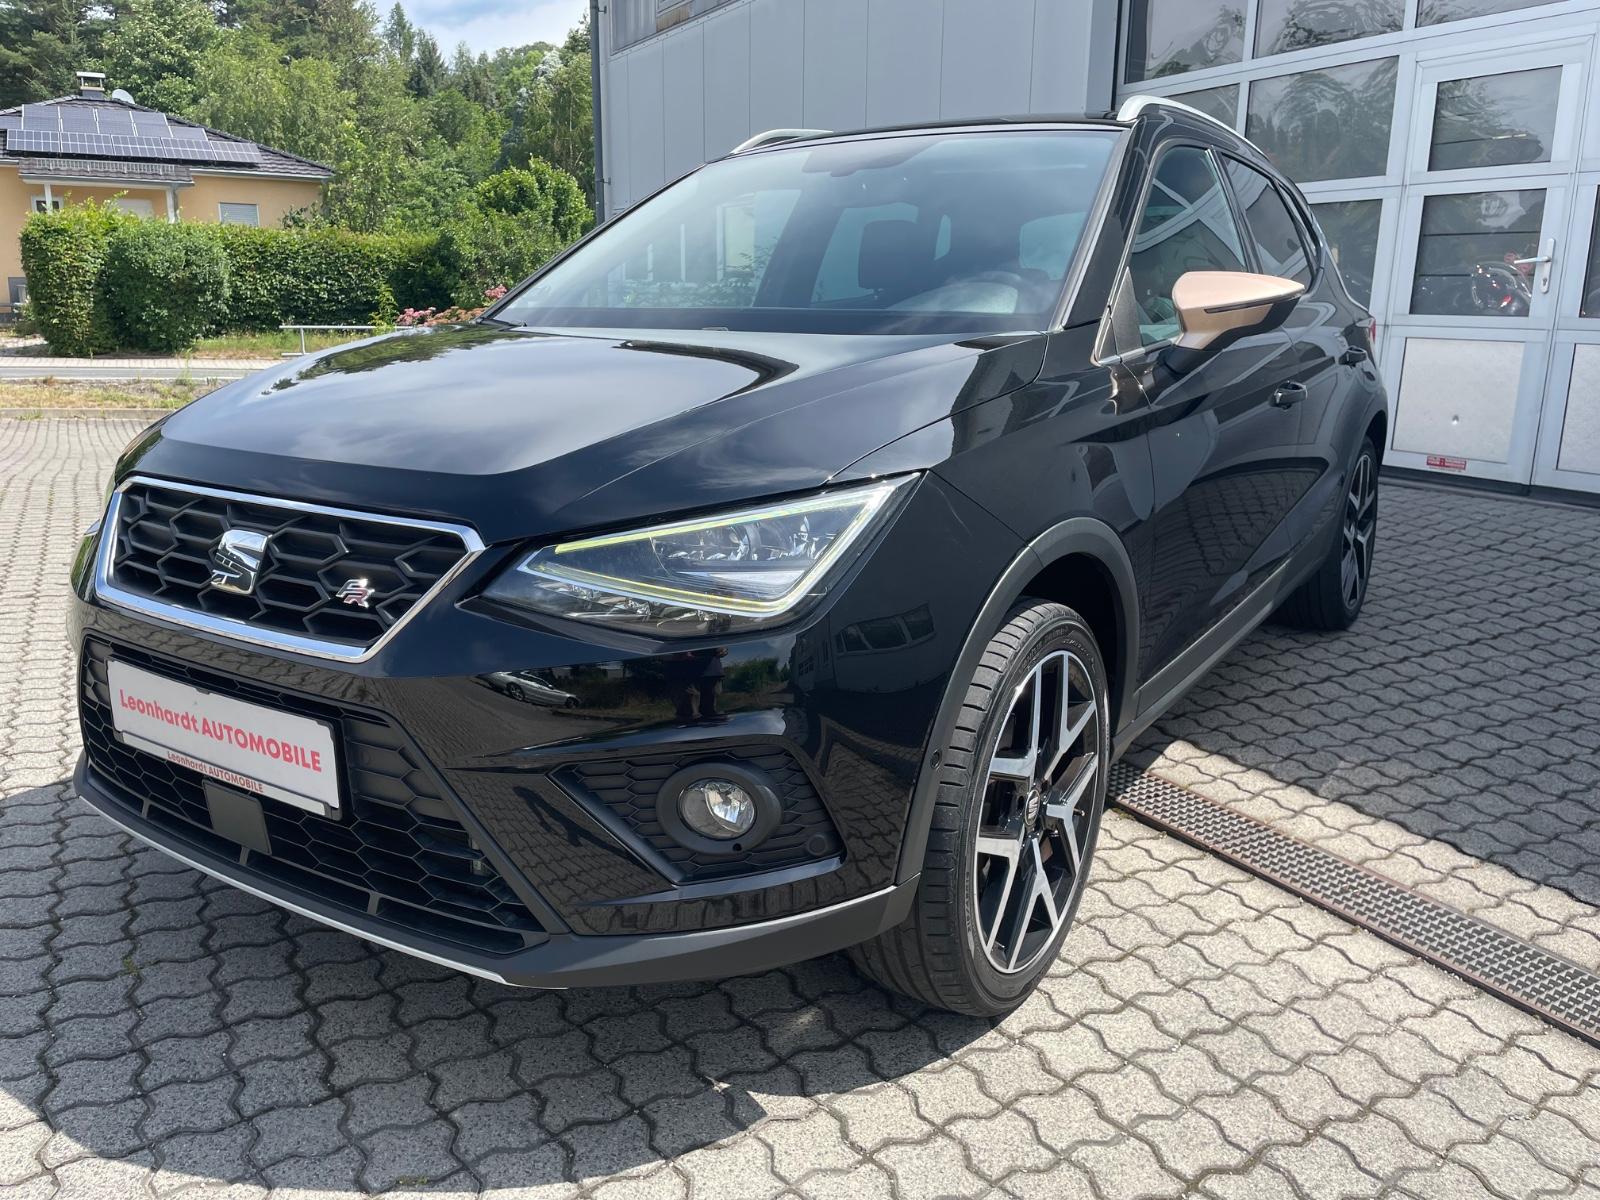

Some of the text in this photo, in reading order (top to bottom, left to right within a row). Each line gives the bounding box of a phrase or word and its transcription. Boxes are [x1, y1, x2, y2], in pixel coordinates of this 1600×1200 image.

[119, 688, 323, 773] Leonhardt AUTOMOBILE
[167, 750, 264, 793] Leonhardt AUTOMOBILE
